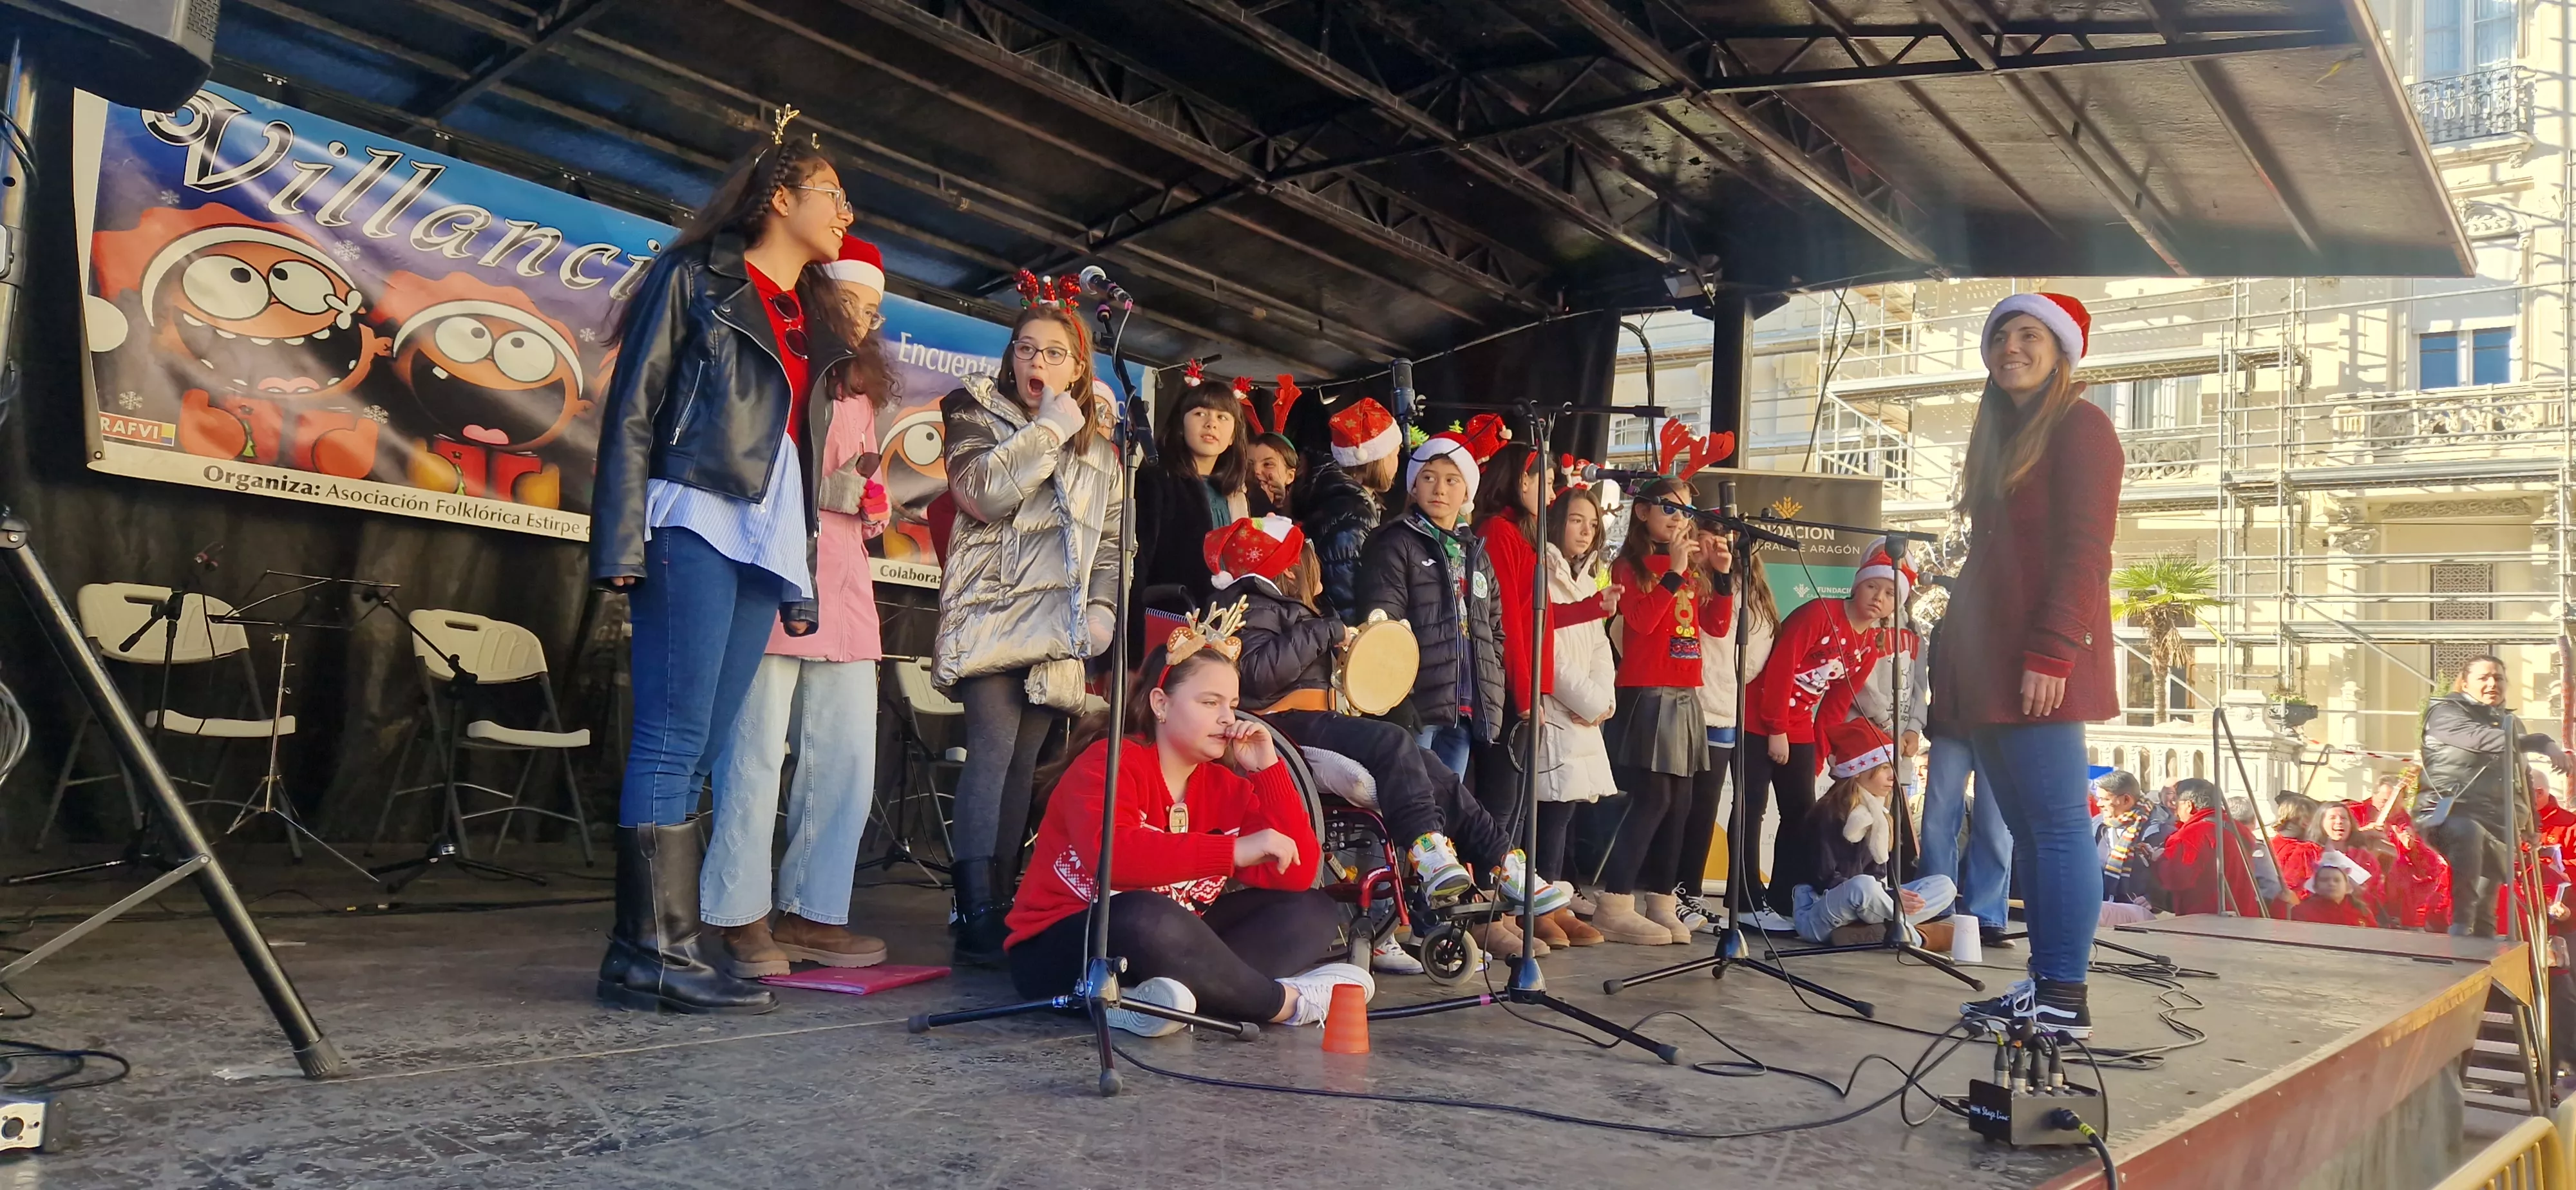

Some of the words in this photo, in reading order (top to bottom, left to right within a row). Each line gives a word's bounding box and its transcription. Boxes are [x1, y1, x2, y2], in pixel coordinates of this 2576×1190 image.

[203, 465, 321, 496] Organiza:
[326, 484, 428, 512] Asociación
[436, 499, 520, 525] Folklórica
[527, 513, 580, 536] Estirpe
[1752, 542, 1787, 551] URAL
[1810, 544, 1860, 554] ARAGÓN
[880, 565, 942, 584] Colabora:
